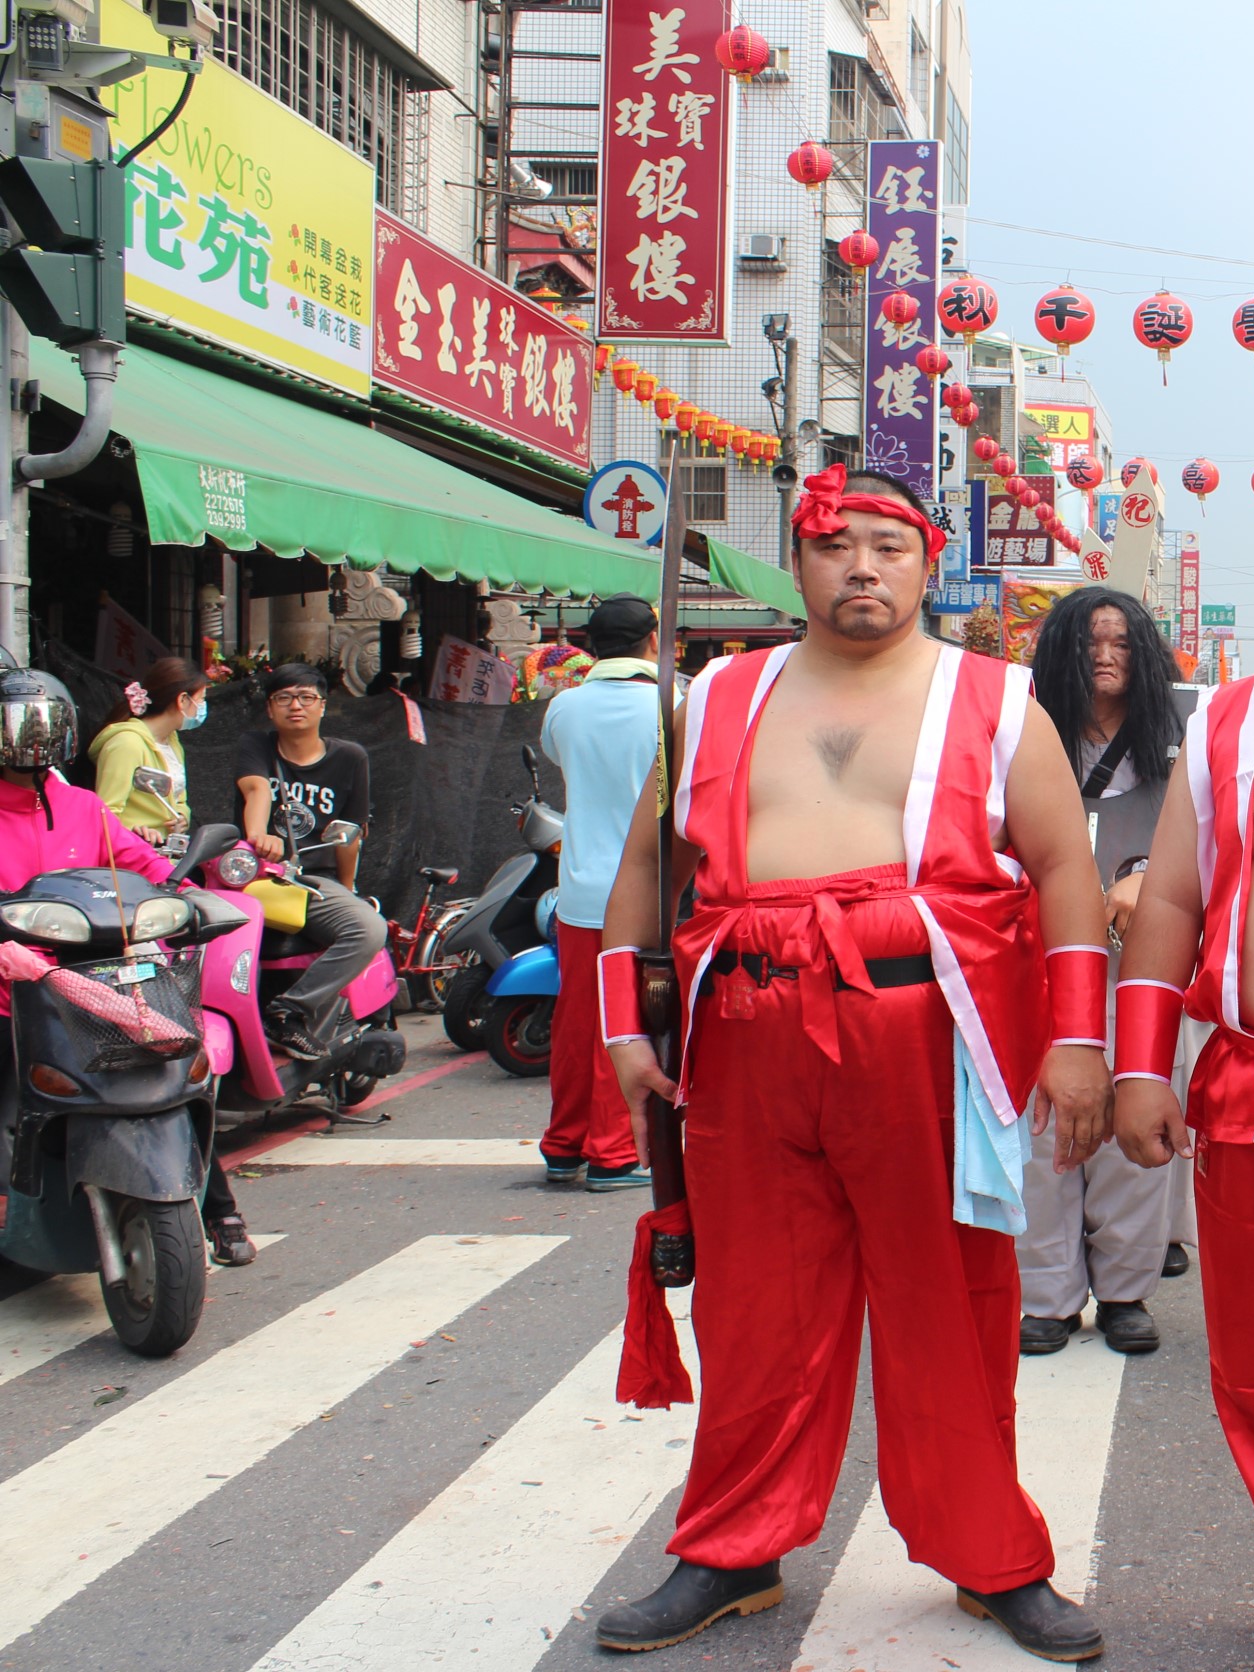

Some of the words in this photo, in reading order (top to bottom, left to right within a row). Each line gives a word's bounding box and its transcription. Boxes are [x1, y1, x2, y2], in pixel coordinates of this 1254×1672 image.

[944, 284, 994, 328] 秋
[1037, 294, 1088, 336] 千
[1140, 302, 1188, 345] 誕
[204, 493, 245, 514] 2272675
[206, 510, 247, 530] 2392995
[621, 497, 634, 532] 消防栓
[1086, 551, 1109, 580] 罪
